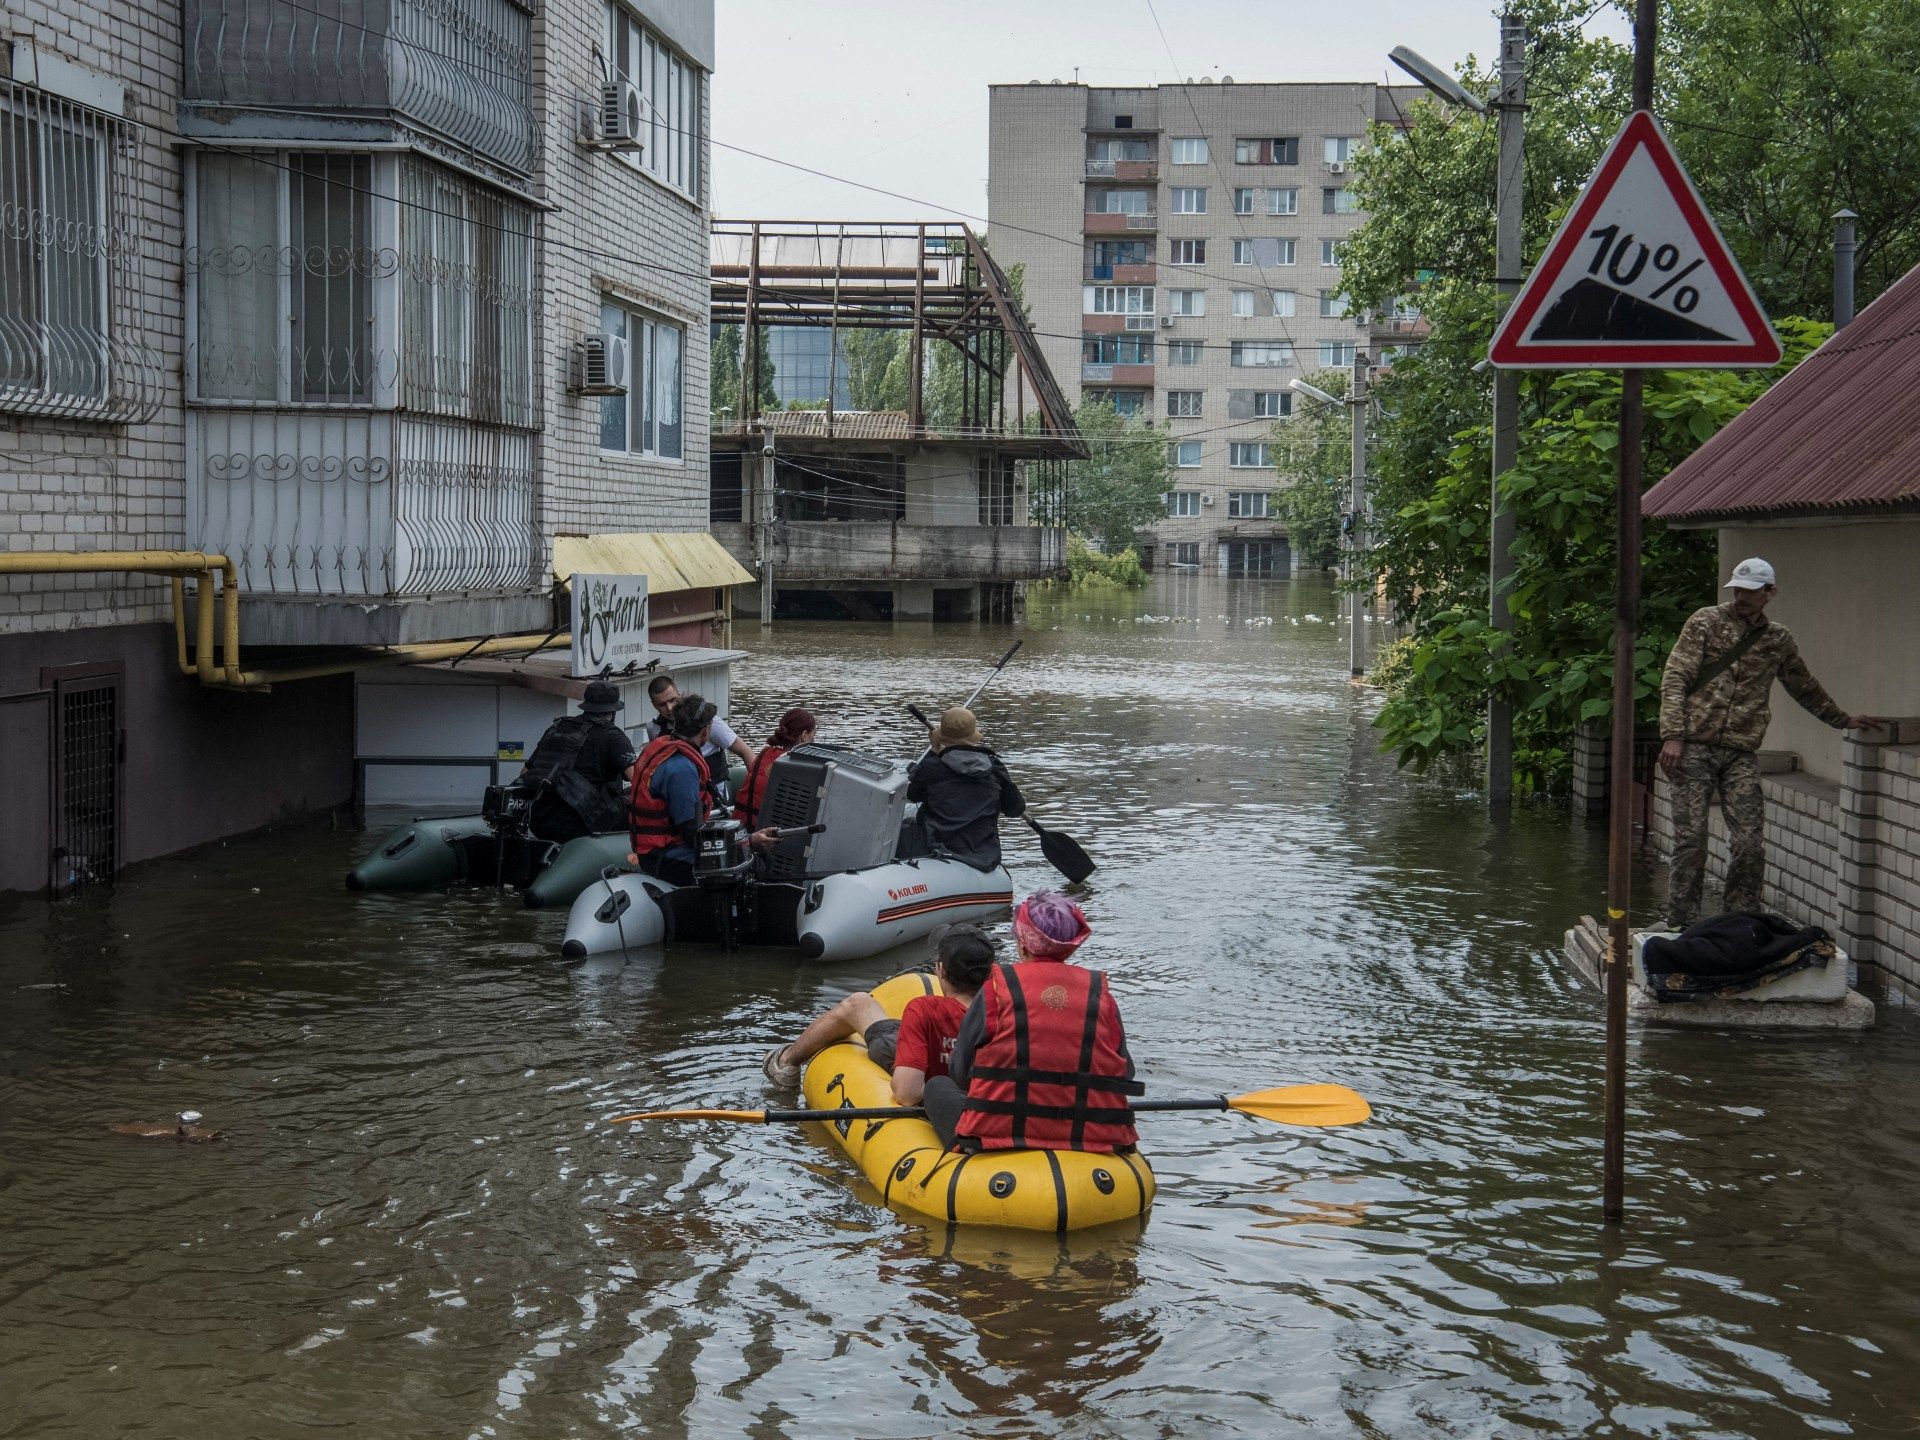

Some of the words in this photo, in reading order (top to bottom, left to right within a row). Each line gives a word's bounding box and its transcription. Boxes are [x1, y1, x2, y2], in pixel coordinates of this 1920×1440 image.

[1587, 224, 1705, 313] 10%
[703, 840, 724, 850] 9.9
[898, 884, 928, 898] KOLIBRI
